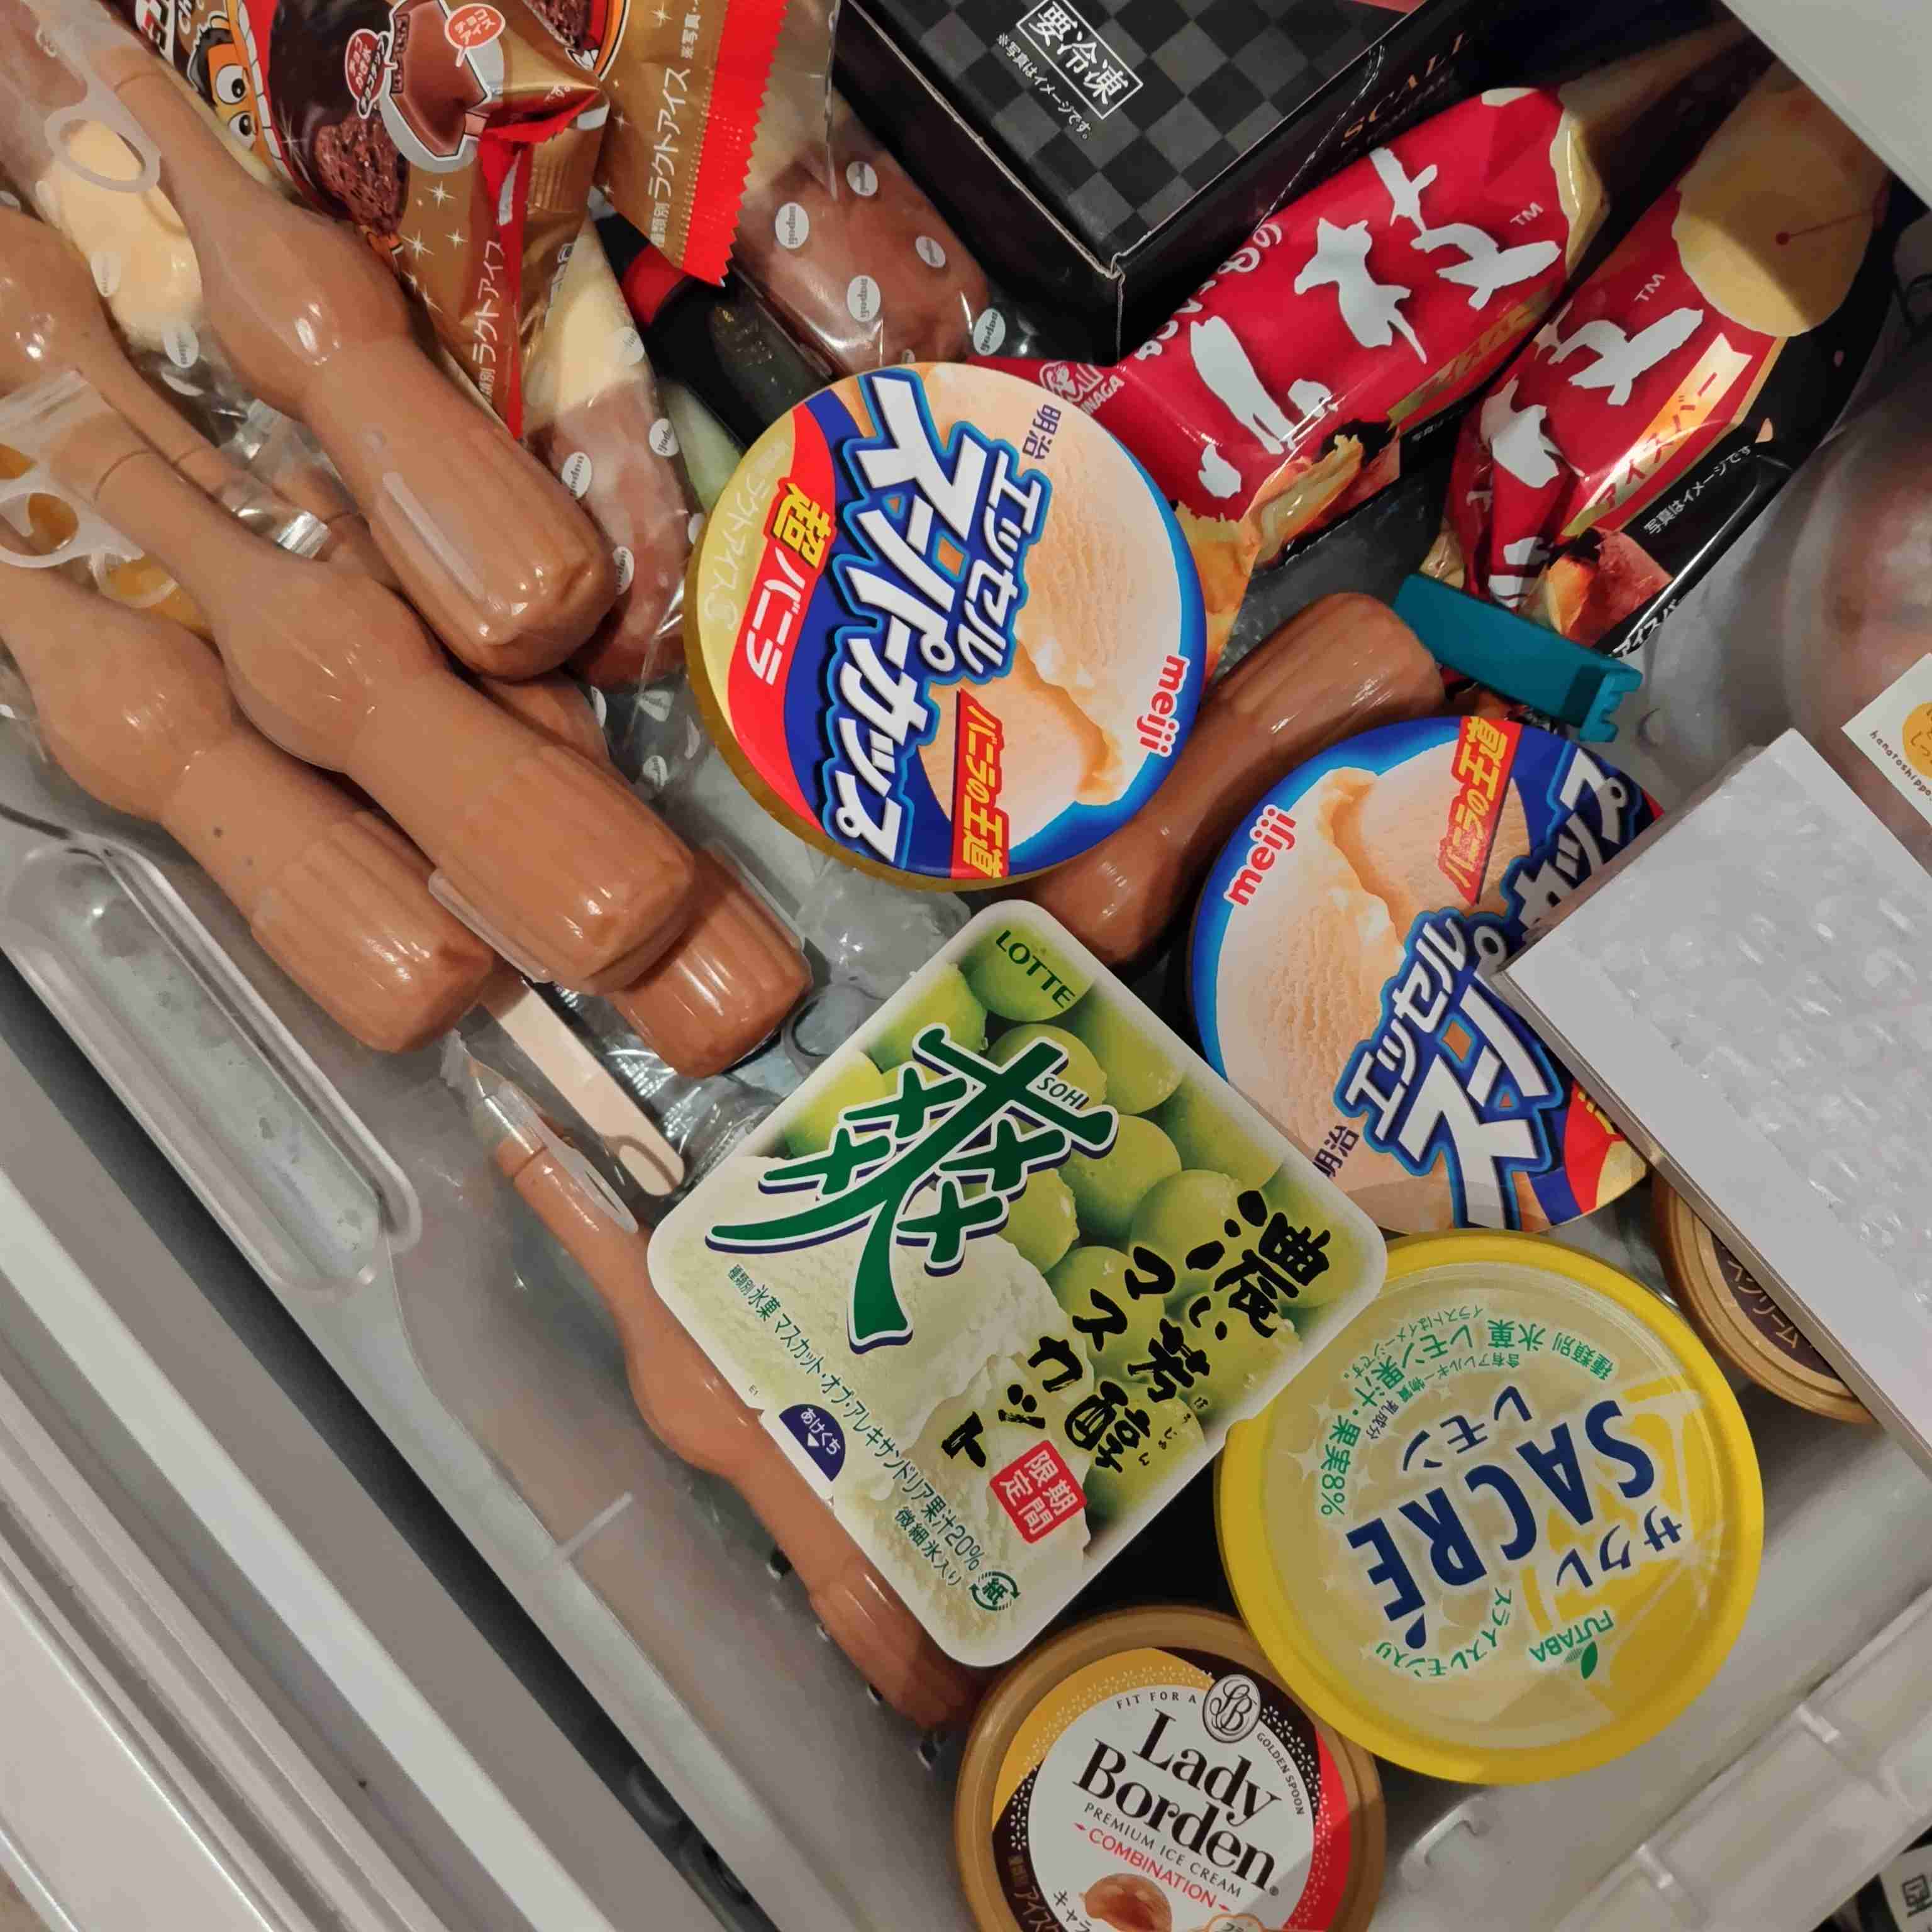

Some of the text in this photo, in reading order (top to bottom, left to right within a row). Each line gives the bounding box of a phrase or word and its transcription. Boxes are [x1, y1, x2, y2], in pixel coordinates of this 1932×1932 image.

[996, 33, 1092, 140] ※写真はイメージです。
[1029, 1, 1128, 104] 要冷凍
[1511, 202, 1543, 226] TM
[1198, 147, 1562, 498] 小枝
[1635, 274, 1665, 302] TM
[1023, 404, 1062, 460] 明治
[1644, 445, 1752, 535] 写真はイメージです
[744, 482, 831, 686] 超バニラ
[957, 450, 1043, 674] エッセル
[835, 375, 989, 863] スーパーカップ
[1136, 654, 1190, 757] meiji
[963, 704, 1004, 879] バニラの王道
[1440, 716, 1509, 890] バニラの王道
[1223, 804, 1297, 908] meiji
[996, 930, 1076, 1009] LOTTE
[1345, 917, 1466, 1141] エッセル
[707, 1026, 1117, 1352] 爽
[941, 1245, 1176, 1468] マスカット
[1487, 1319, 1546, 1352] 氷菓
[1552, 1331, 1614, 1380] 種類別
[801, 1407, 841, 1456] あけくち
[1402, 1385, 1533, 1472] レモン
[894, 1506, 962, 1586] 微細氷入り
[982, 1577, 1009, 1605] 紙
[1555, 1504, 1684, 1589] サクレ
[1375, 1586, 1512, 1679] スライスレモン入り
[1530, 1609, 1615, 1663] FUTABA
[1116, 1691, 1197, 1709] FIT FOR A
[1133, 1708, 1282, 1827] Lady
[1257, 1731, 1305, 1816] GOLDEN SPOON
[1072, 1738, 1278, 1891] Borden
[1084, 1802, 1241, 1898] PREMIUM ICE CREAM
[1089, 1828, 1218, 1909] COMBINATION
